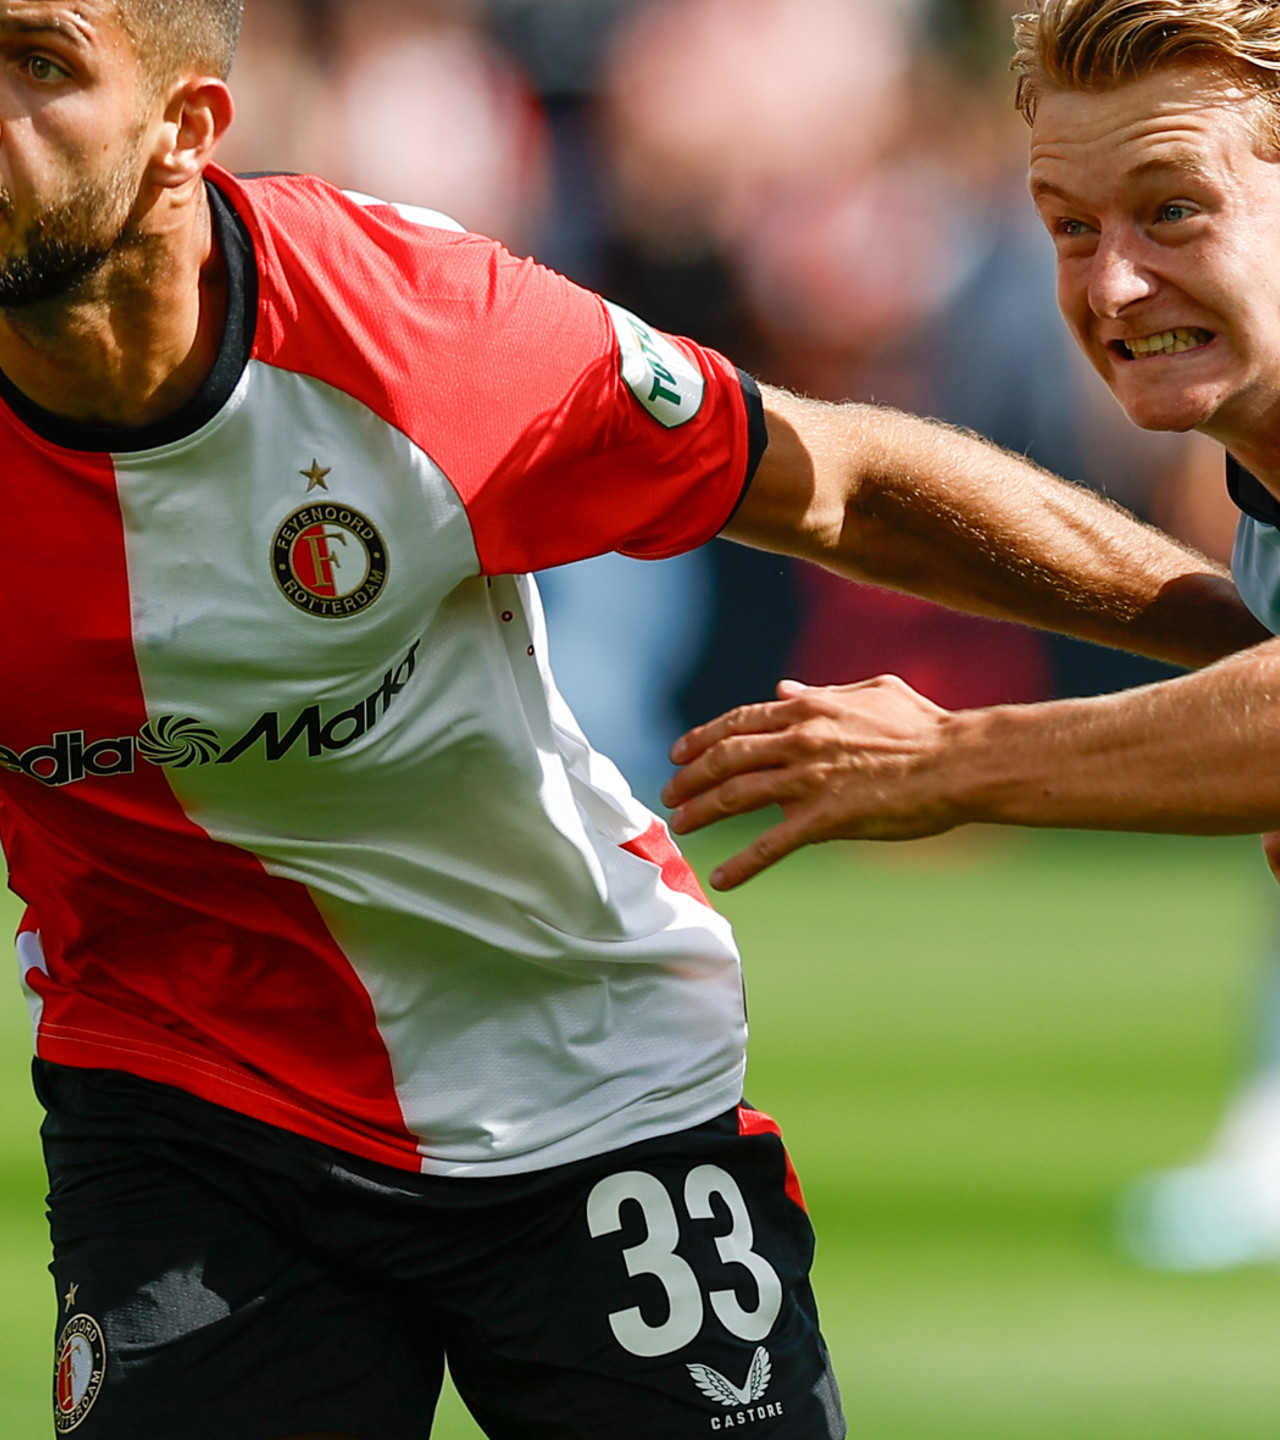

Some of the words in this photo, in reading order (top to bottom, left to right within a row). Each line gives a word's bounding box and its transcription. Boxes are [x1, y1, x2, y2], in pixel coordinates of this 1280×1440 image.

[276, 506, 375, 550] FEYENOORD
[302, 532, 348, 588] F
[283, 569, 384, 614] ROTTERDAM
[586, 1163, 783, 1358] 33
[710, 1401, 784, 1431] CASTORE
